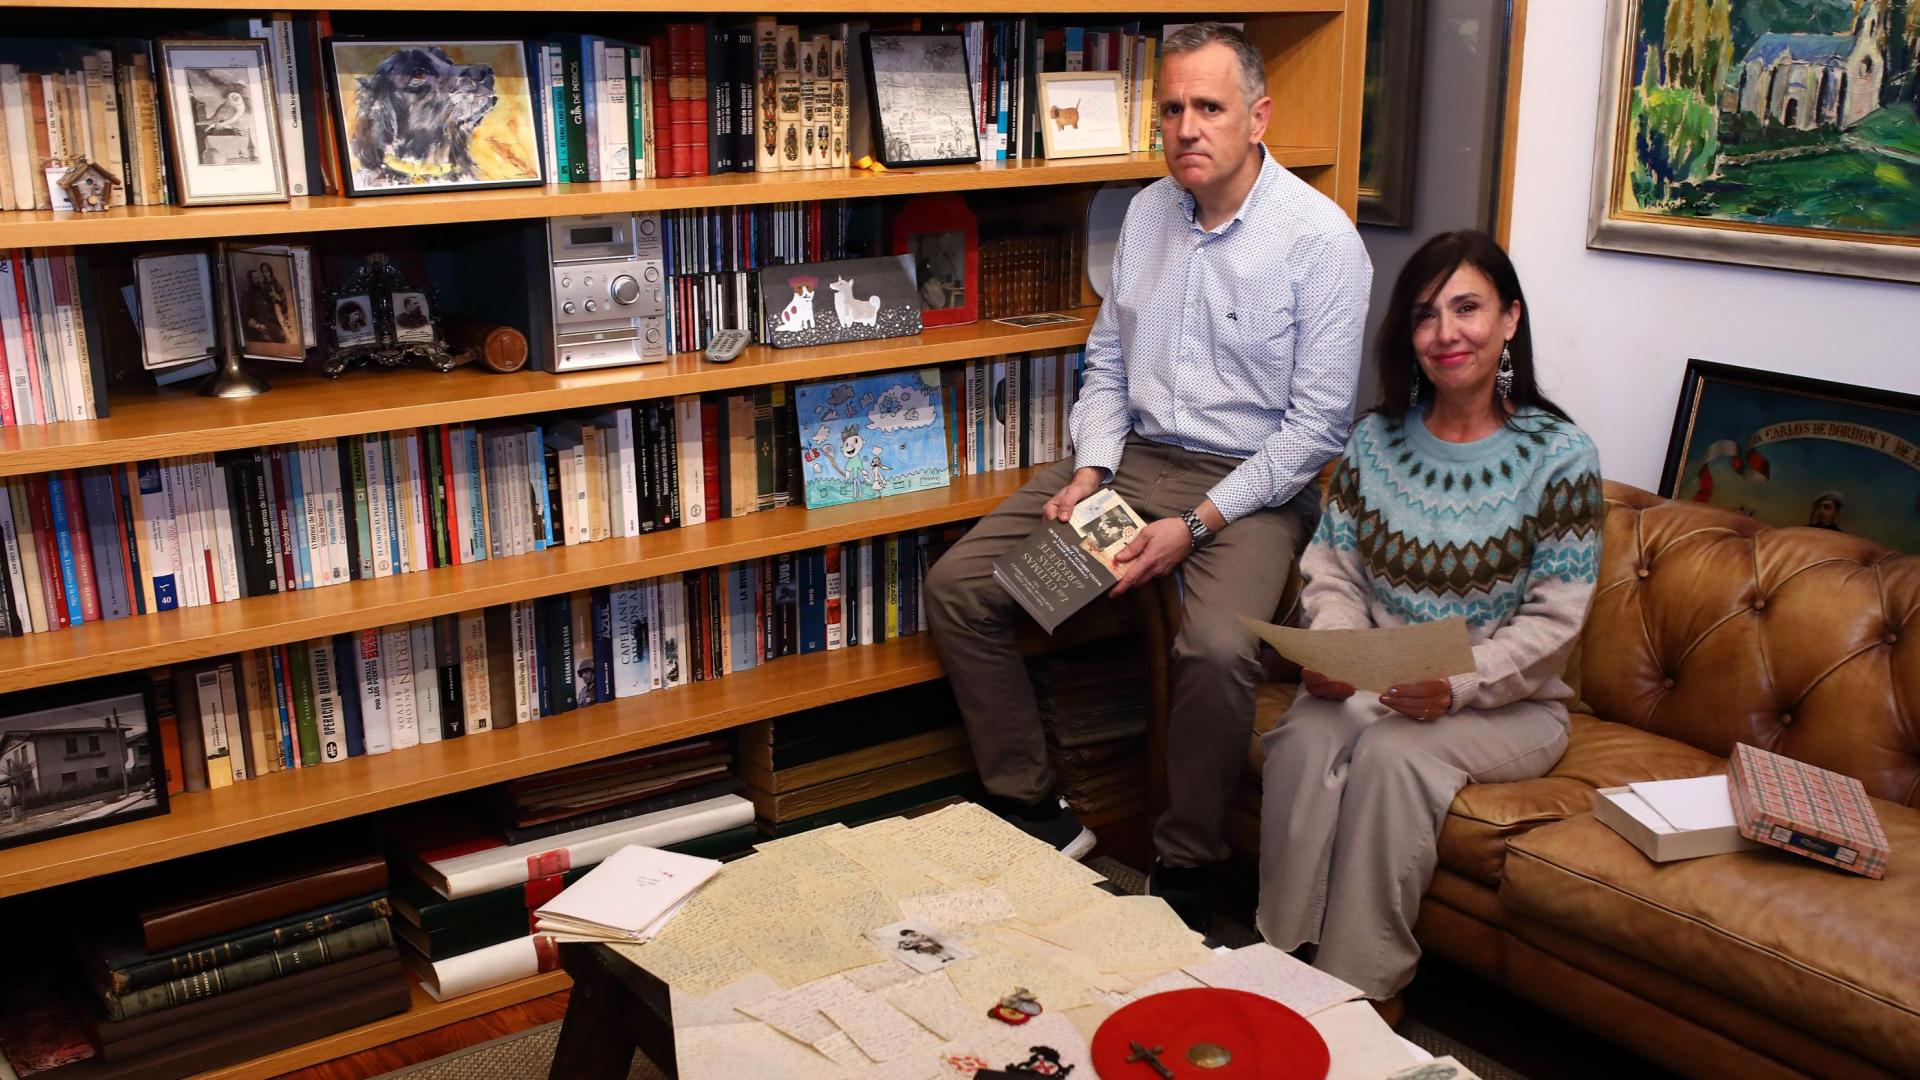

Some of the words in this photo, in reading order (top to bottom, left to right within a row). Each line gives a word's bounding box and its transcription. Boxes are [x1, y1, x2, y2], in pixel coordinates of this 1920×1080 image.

[287, 70, 295, 99] castellano
[571, 61, 579, 91] PERROS
[573, 93, 579, 103] DE
[1765, 423, 1810, 439] CARLOS
[1812, 422, 1826, 435] DE
[257, 476, 265, 500] Navarra
[371, 486, 380, 517] PEREGRINO
[306, 492, 314, 515] Navarra
[263, 528, 270, 536] de
[283, 530, 291, 555] Pacharán
[264, 537, 272, 558] escudo
[1037, 539, 1078, 584] REQUETÉ
[1019, 551, 1059, 593] ÚLTIMAS
[1037, 554, 1070, 590] CARTAS
[1073, 578, 1086, 592] del
[161, 596, 171, 604] 40
[1054, 588, 1070, 604] Las
[601, 603, 610, 639] AZUL
[618, 593, 630, 665] CAPELLANES
[394, 628, 410, 685] BERLIN
[315, 649, 330, 694] BARBARROJA
[466, 646, 476, 702] LENINGRADO
[320, 697, 335, 735] OPERACION
[470, 703, 477, 713] DE
